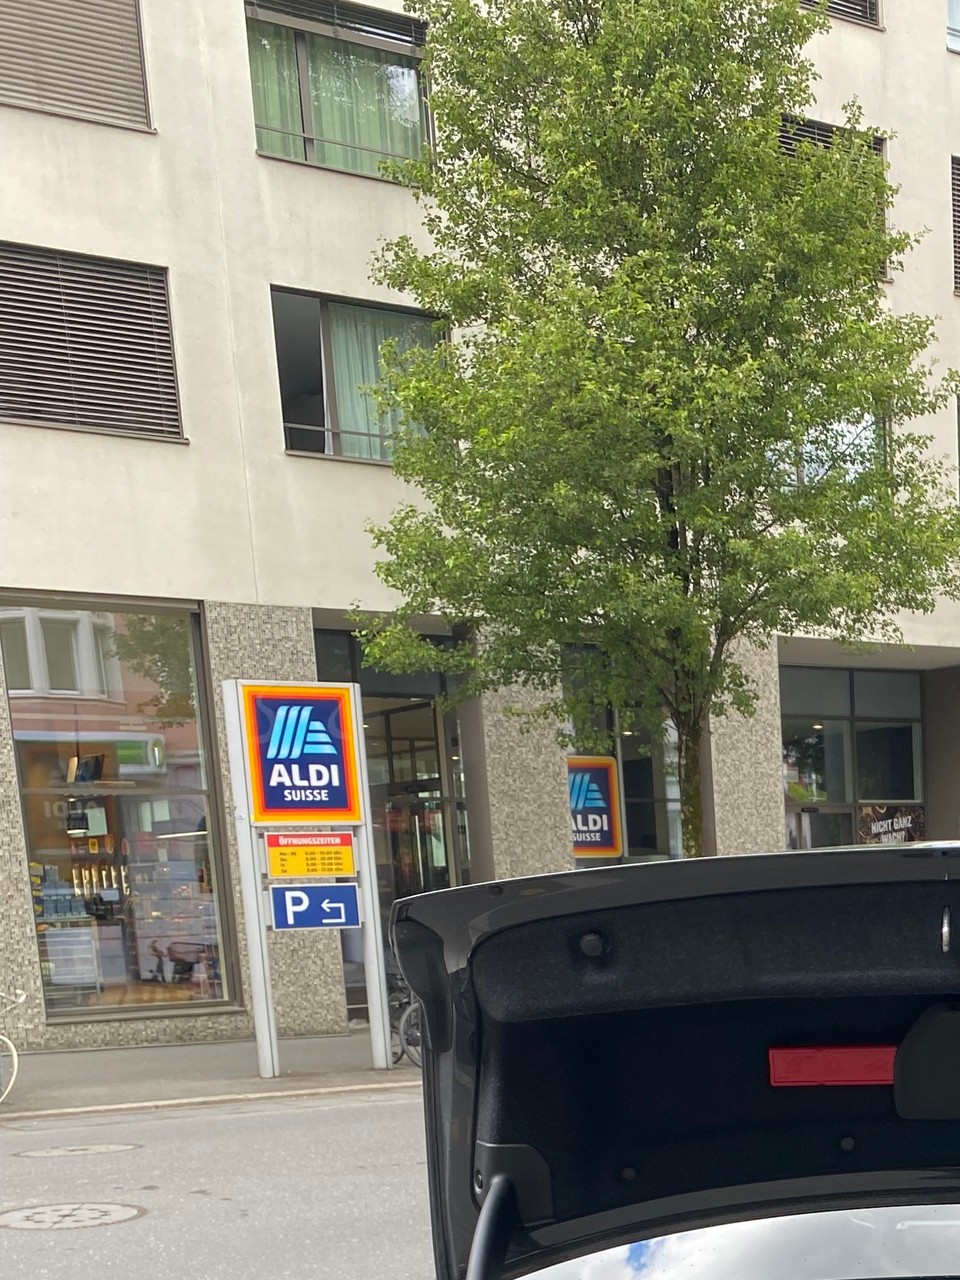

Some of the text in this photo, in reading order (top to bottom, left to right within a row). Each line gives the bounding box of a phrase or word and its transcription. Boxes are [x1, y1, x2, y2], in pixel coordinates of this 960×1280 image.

[269, 763, 340, 787] ALDI
[283, 789, 330, 801] SUISSE
[871, 815, 913, 834] NICHT GANZ
[278, 836, 341, 845] ÖFFNUNGSZEITEN
[284, 890, 310, 925] P
